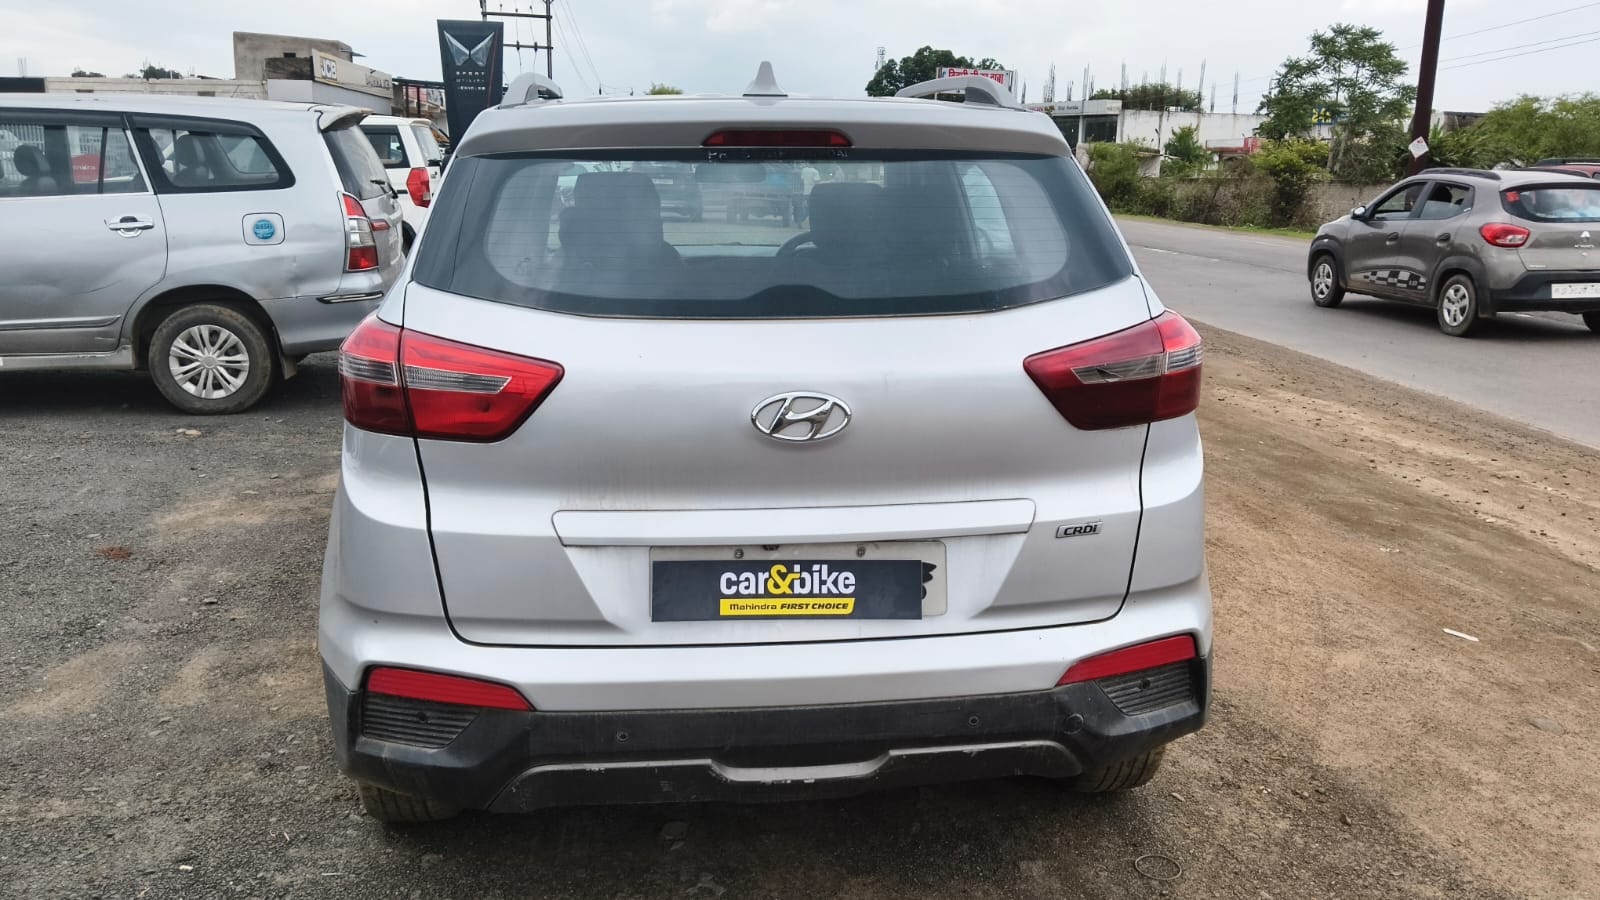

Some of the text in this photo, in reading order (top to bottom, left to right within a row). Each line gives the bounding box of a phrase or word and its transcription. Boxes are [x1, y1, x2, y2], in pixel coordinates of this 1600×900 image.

[320, 58, 337, 80] JCB
[720, 564, 856, 596] car&bike
[729, 602, 849, 611] Mahindra FIRST CHOICE
